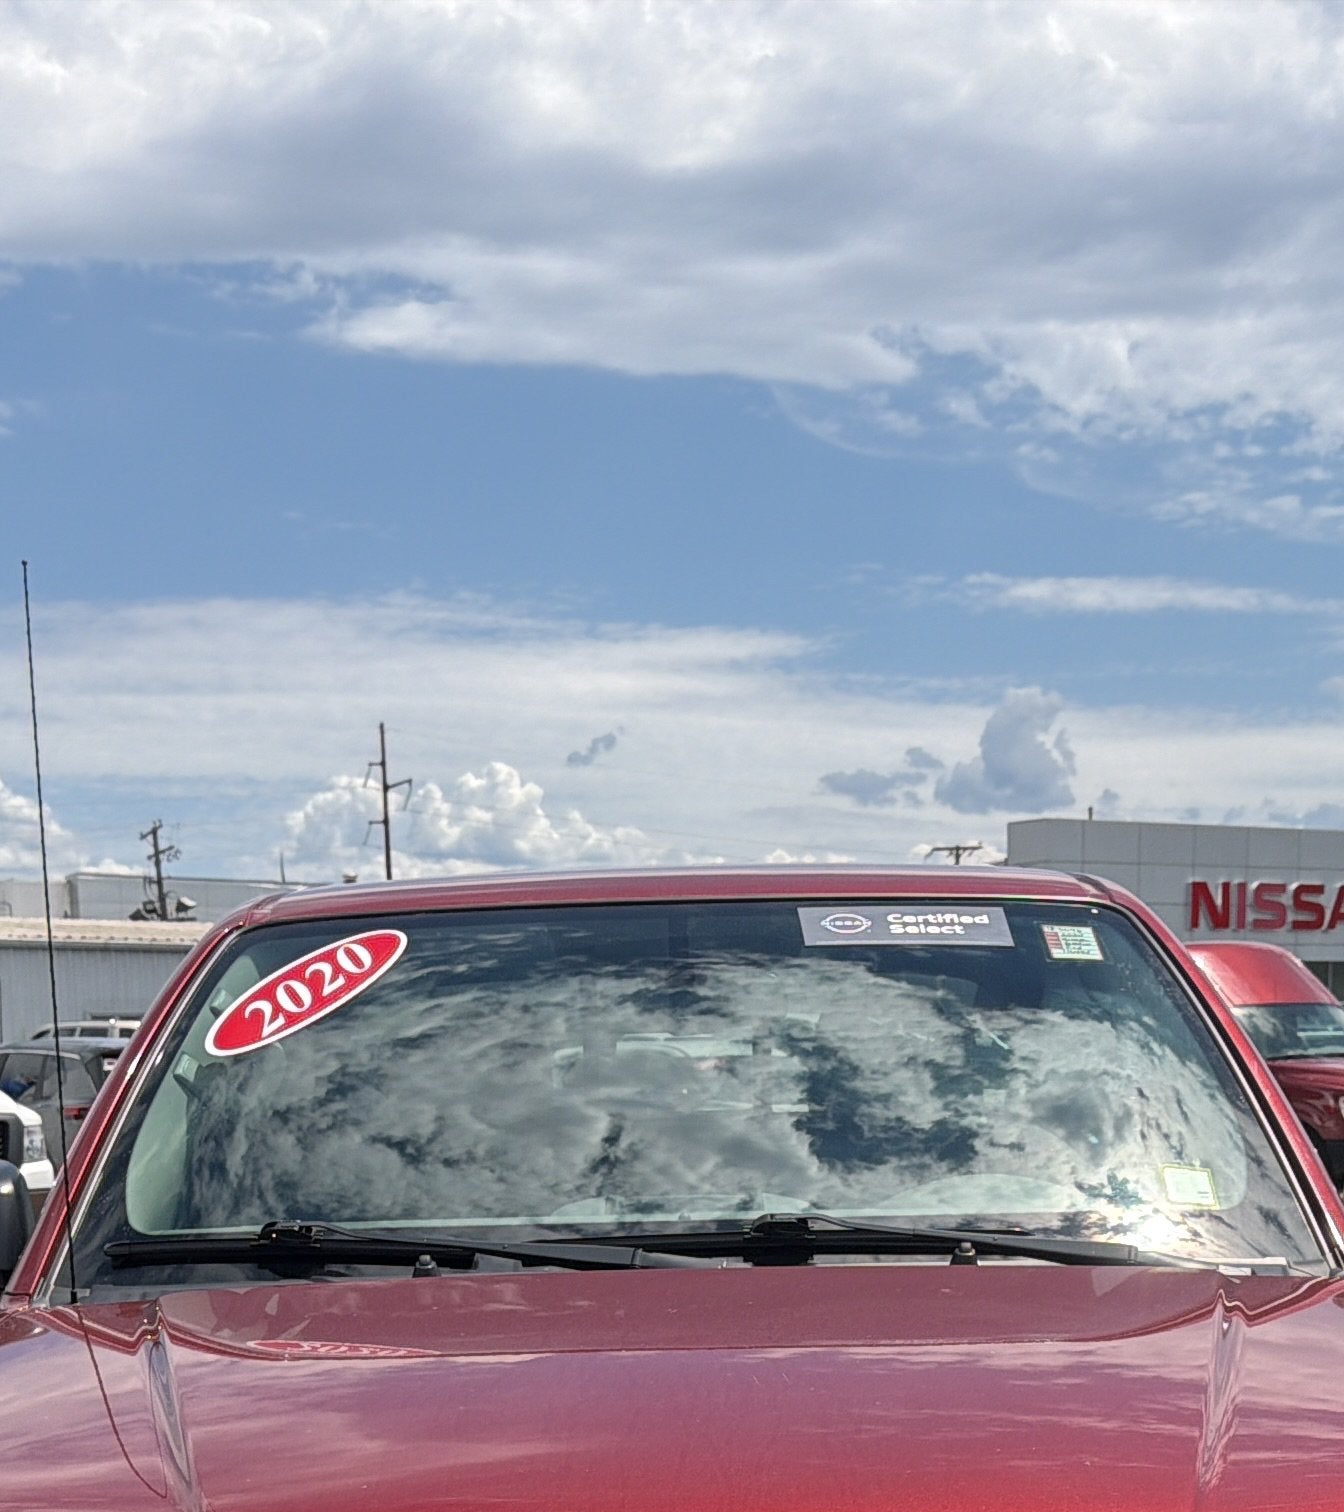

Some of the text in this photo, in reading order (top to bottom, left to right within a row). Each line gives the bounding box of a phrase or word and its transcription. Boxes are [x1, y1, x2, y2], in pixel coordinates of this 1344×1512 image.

[886, 913, 990, 925] Certified
[889, 924, 966, 935] Select
[244, 943, 373, 1039] 2020
